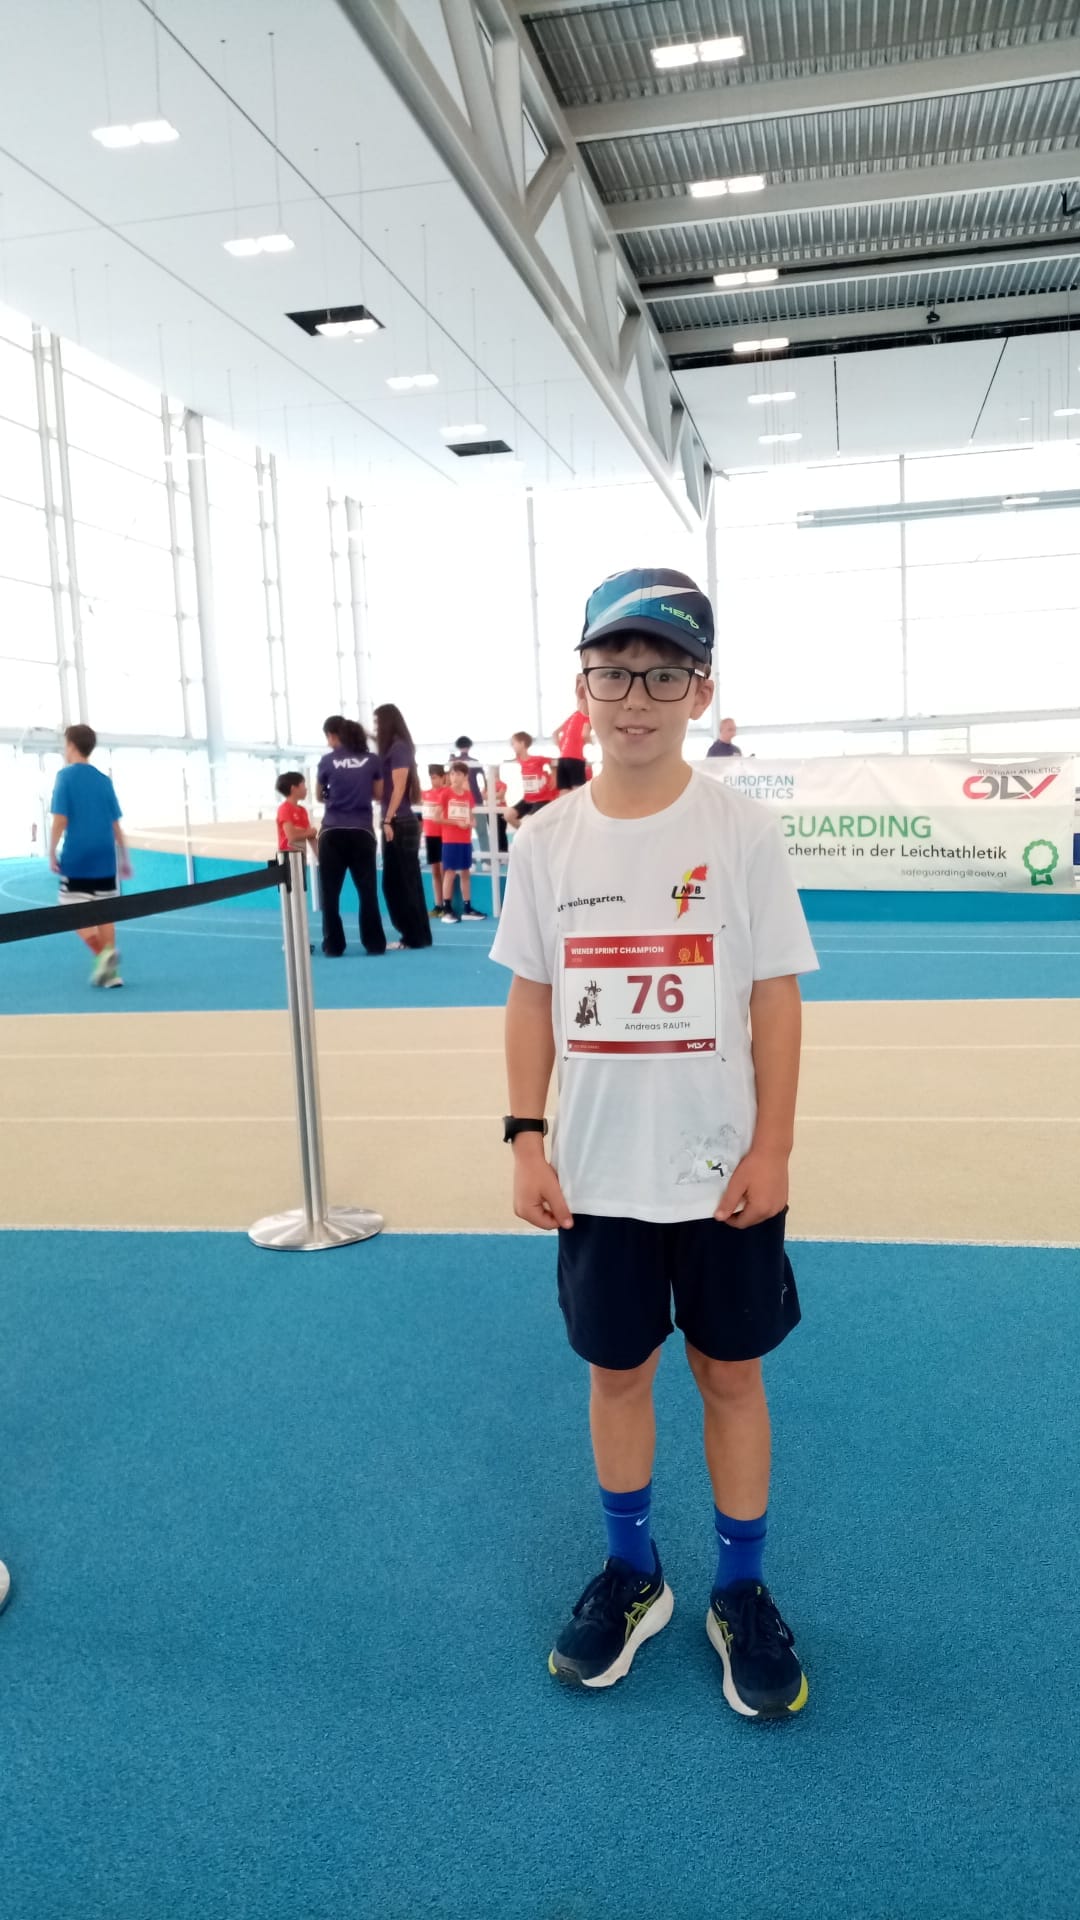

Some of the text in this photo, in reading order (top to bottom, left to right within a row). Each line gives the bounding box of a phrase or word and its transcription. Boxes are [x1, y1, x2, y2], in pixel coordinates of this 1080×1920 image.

[660, 603, 699, 629] HEAD
[333, 757, 369, 769] WLV
[1018, 766, 1062, 775] ATHLETICS
[723, 775, 794, 787] EUROPEAN
[781, 815, 932, 838] GUARDING
[788, 843, 1007, 860] cherheit in der Leichtathletik
[571, 947, 594, 955] WIENER
[619, 946, 665, 954] CHAMPION
[627, 973, 684, 1014] 76
[624, 1022, 691, 1031] Andreas RAUTH
